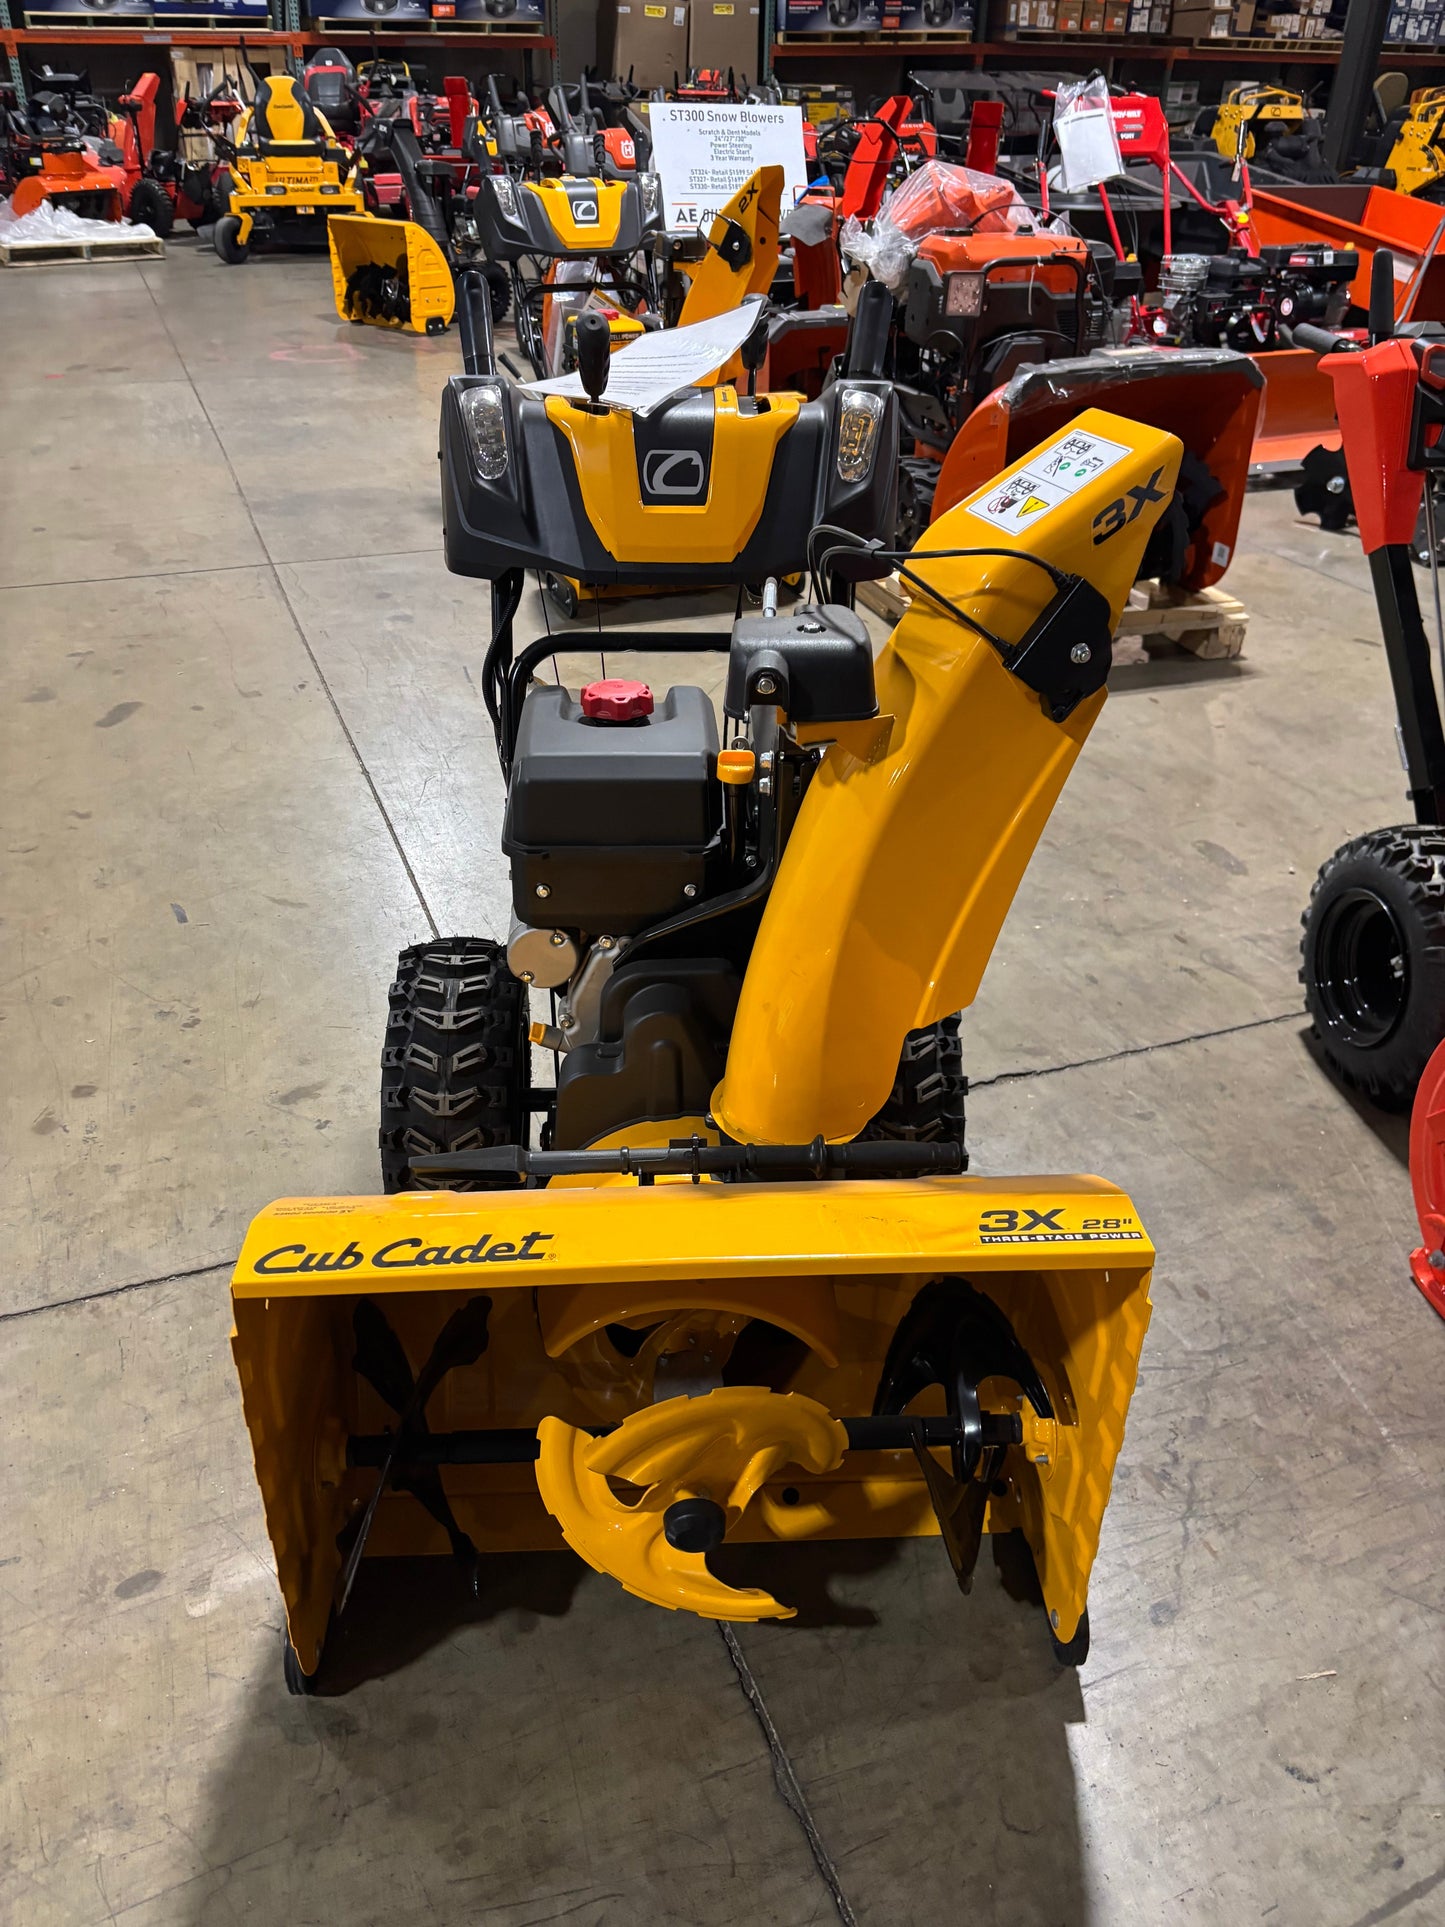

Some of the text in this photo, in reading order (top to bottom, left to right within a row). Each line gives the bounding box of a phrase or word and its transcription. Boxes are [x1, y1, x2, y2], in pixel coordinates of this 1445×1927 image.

[670, 110, 784, 123] ST300 Snow Blowers
[729, 142, 752, 150] Steering
[728, 155, 754, 163] Warranty
[738, 182, 760, 215] 2X
[676, 208, 698, 223] AE
[1092, 465, 1168, 545] 3X
[979, 1208, 1132, 1232] 3X 28"
[982, 1232, 1141, 1244] THREE-STAGE POWER
[253, 1231, 556, 1275] Cub Cadet
